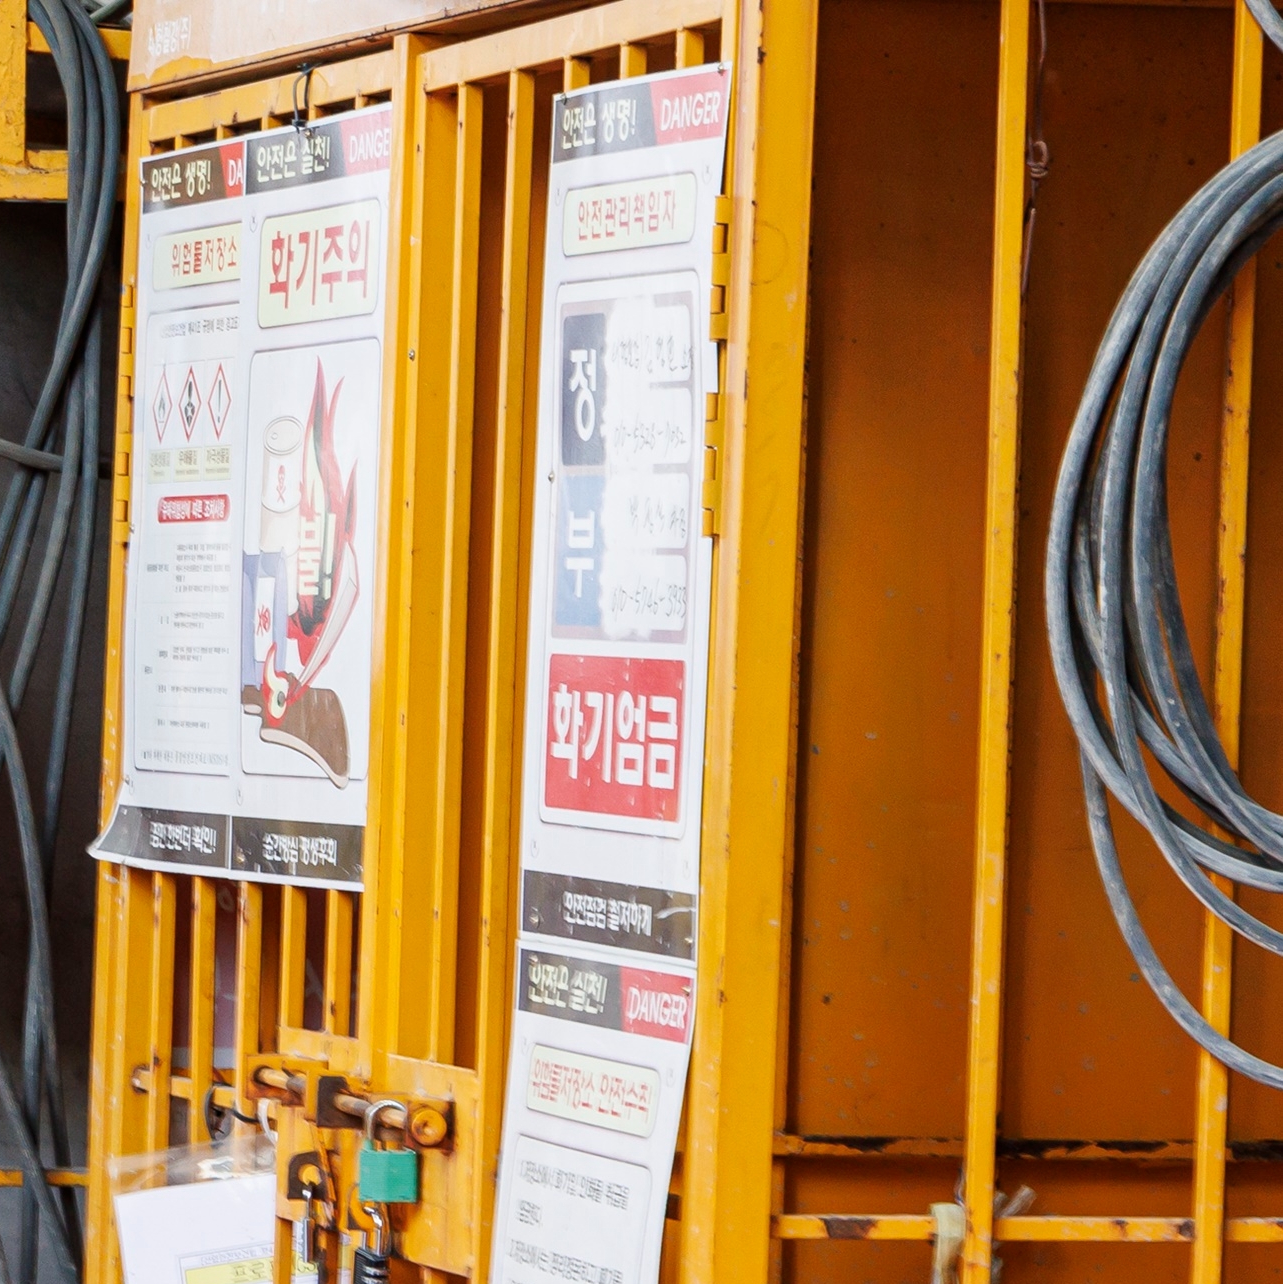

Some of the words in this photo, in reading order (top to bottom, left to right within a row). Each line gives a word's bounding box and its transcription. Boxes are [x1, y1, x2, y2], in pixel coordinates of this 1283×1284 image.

[562, 103, 596, 150] 안전은
[601, 99, 637, 144] 생명!
[659, 91, 722, 131] DANGER
[256, 140, 297, 183] 안전은
[348, 130, 390, 164] DANGE
[151, 163, 182, 203] 안전은
[185, 159, 212, 198] 생명!
[577, 189, 677, 242] 안전관리책임자
[171, 234, 238, 277] 위험물저장소
[268, 220, 371, 310] 화기주의
[569, 348, 597, 442] 정
[298, 512, 337, 600] 불!
[564, 510, 596, 599] 부
[550, 682, 679, 790] 화기엄금
[563, 890, 606, 931] 안전점검
[606, 897, 653, 938] 철저하게
[528, 963, 569, 1009] 안전은
[569, 969, 608, 1015] 실천!
[627, 986, 687, 1030] DANGER
[532, 1057, 595, 1110] 위험물저장소
[597, 1074, 652, 1124] 안전수칙
